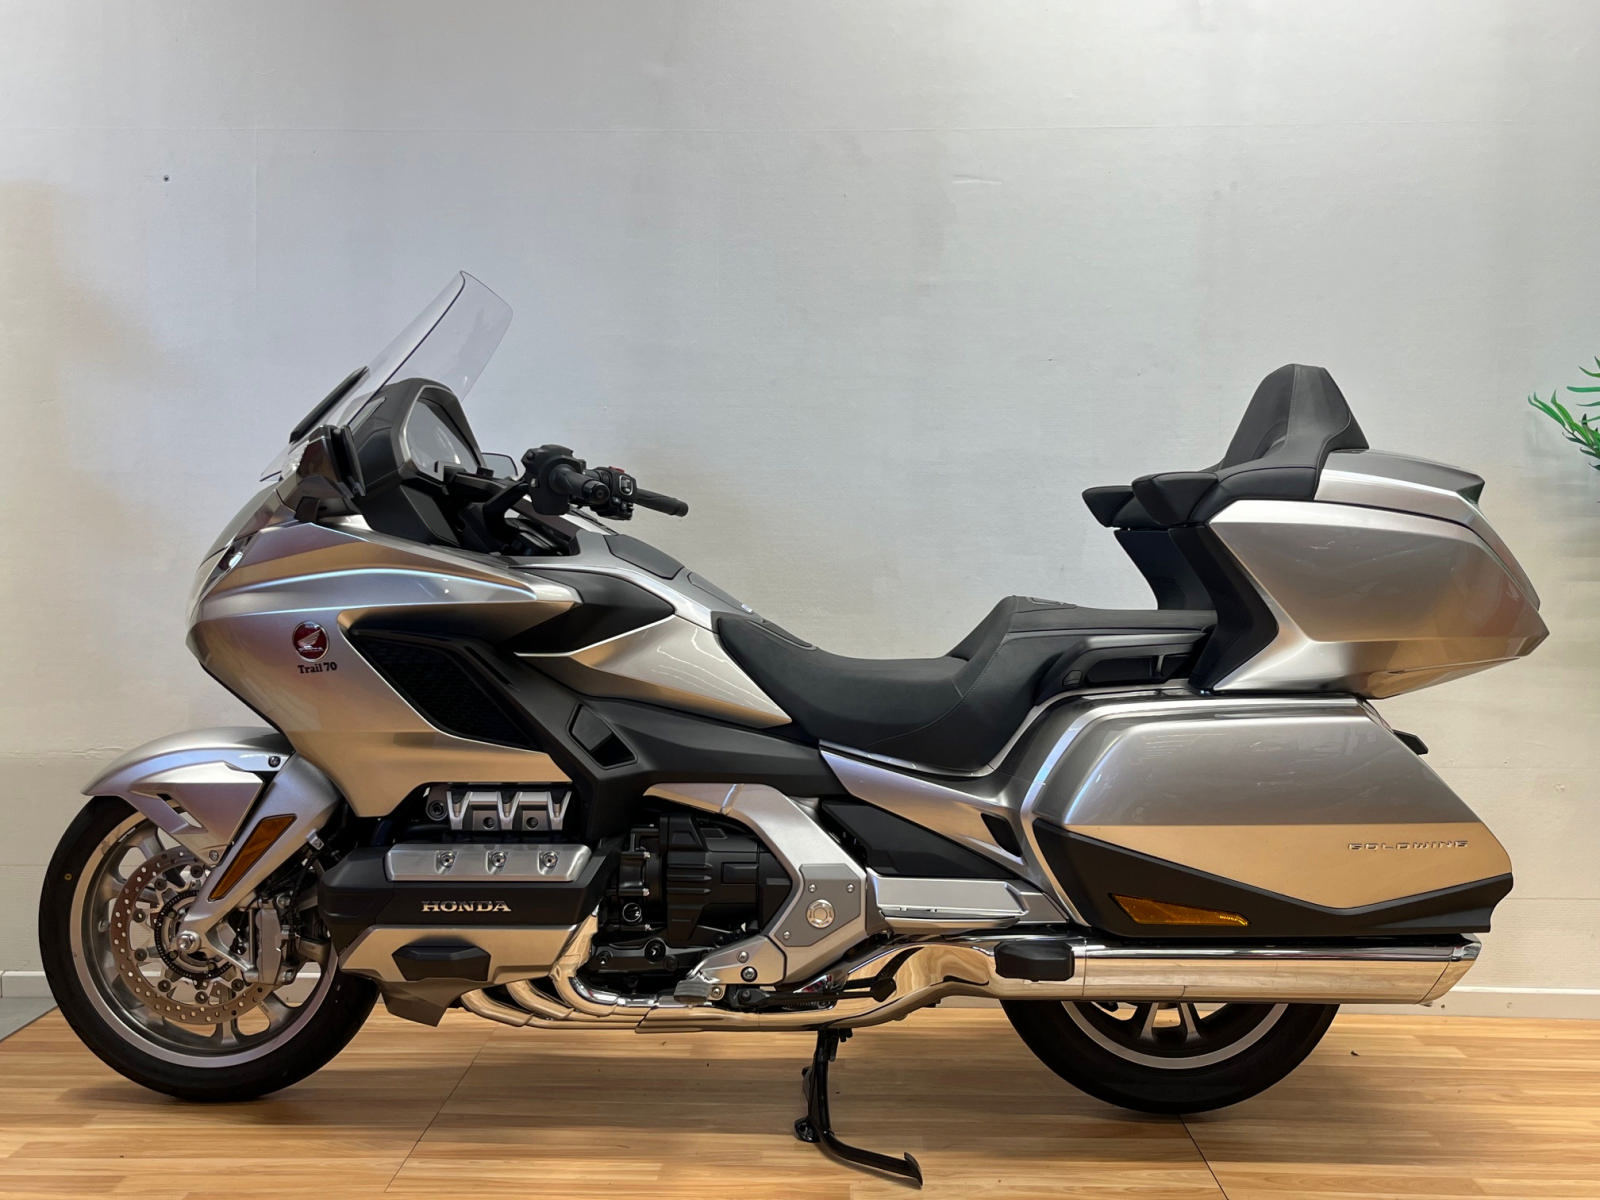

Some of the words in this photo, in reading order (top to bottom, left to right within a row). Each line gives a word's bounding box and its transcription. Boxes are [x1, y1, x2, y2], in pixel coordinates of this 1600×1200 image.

[297, 664, 323, 674] Trail
[323, 661, 338, 672] 70
[1347, 840, 1469, 851] GOLDWING
[421, 900, 511, 912] HONDA
